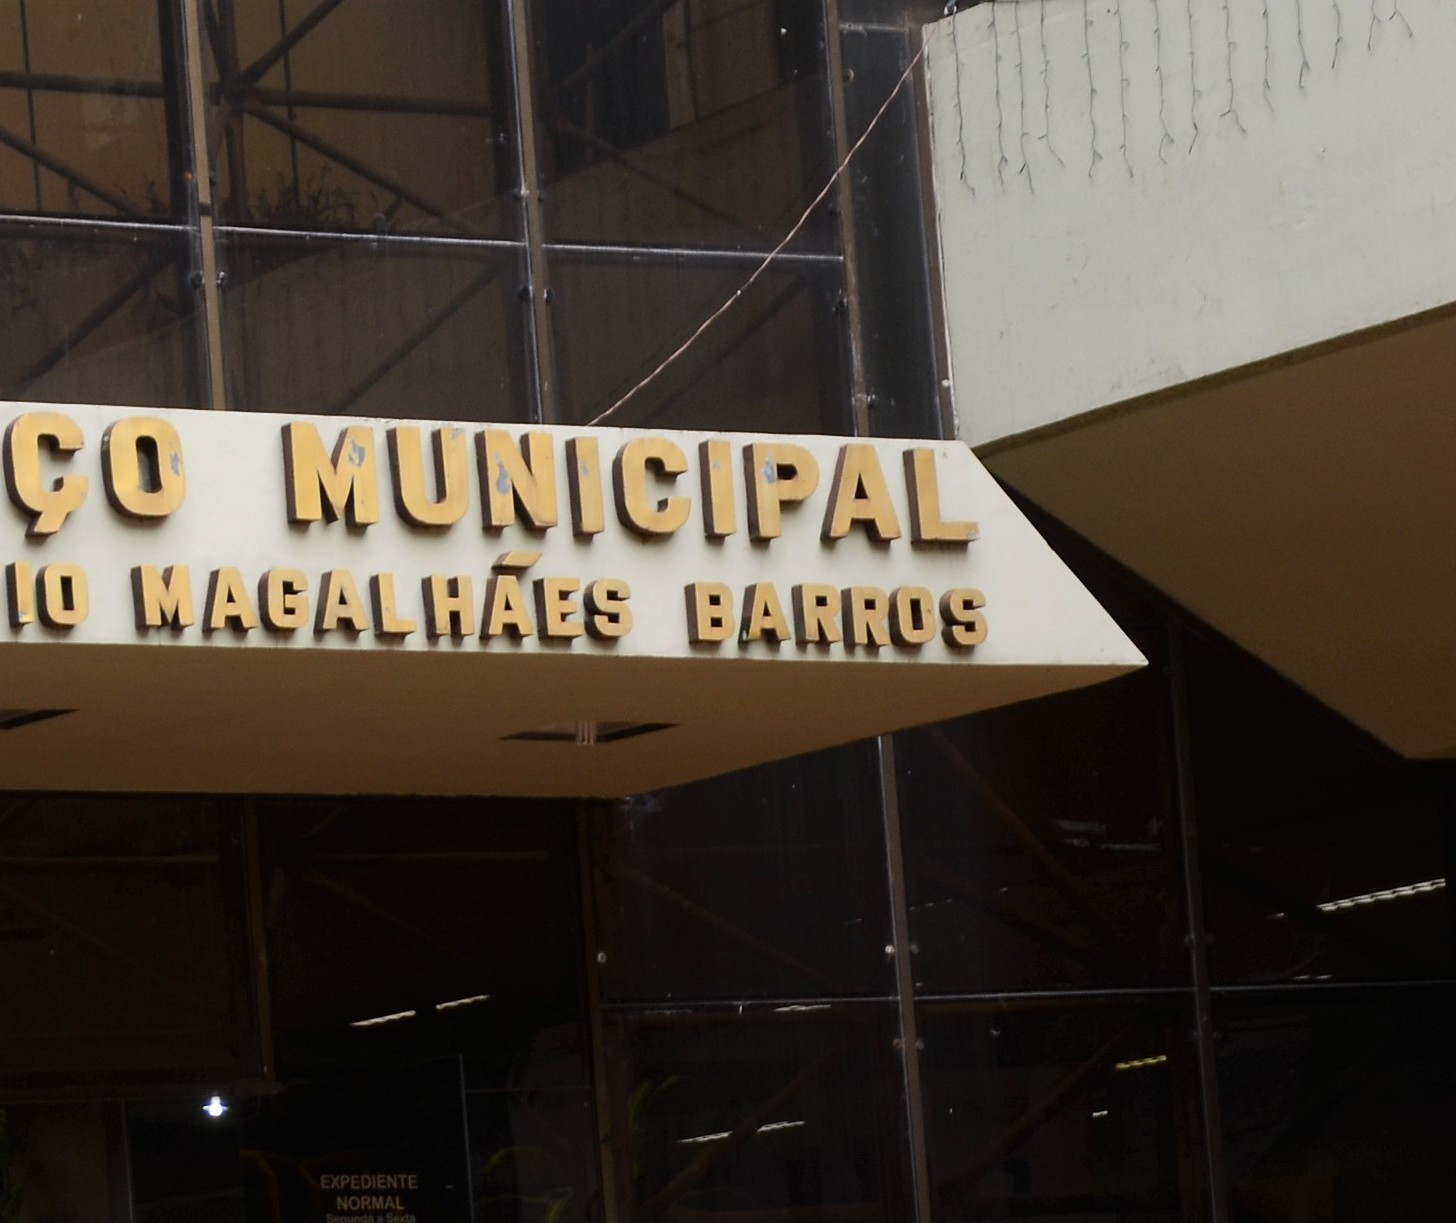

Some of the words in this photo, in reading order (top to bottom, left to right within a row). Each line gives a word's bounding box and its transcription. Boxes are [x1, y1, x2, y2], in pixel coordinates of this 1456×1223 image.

[281, 421, 980, 545] MUNICIPAL
[131, 551, 633, 641] MAGALHÃES
[684, 581, 989, 649] BARROS
[320, 1174, 418, 1190] EXPEDIENTE
[336, 1195, 406, 1211] NORMAL
[377, 1216, 384, 1223] a
